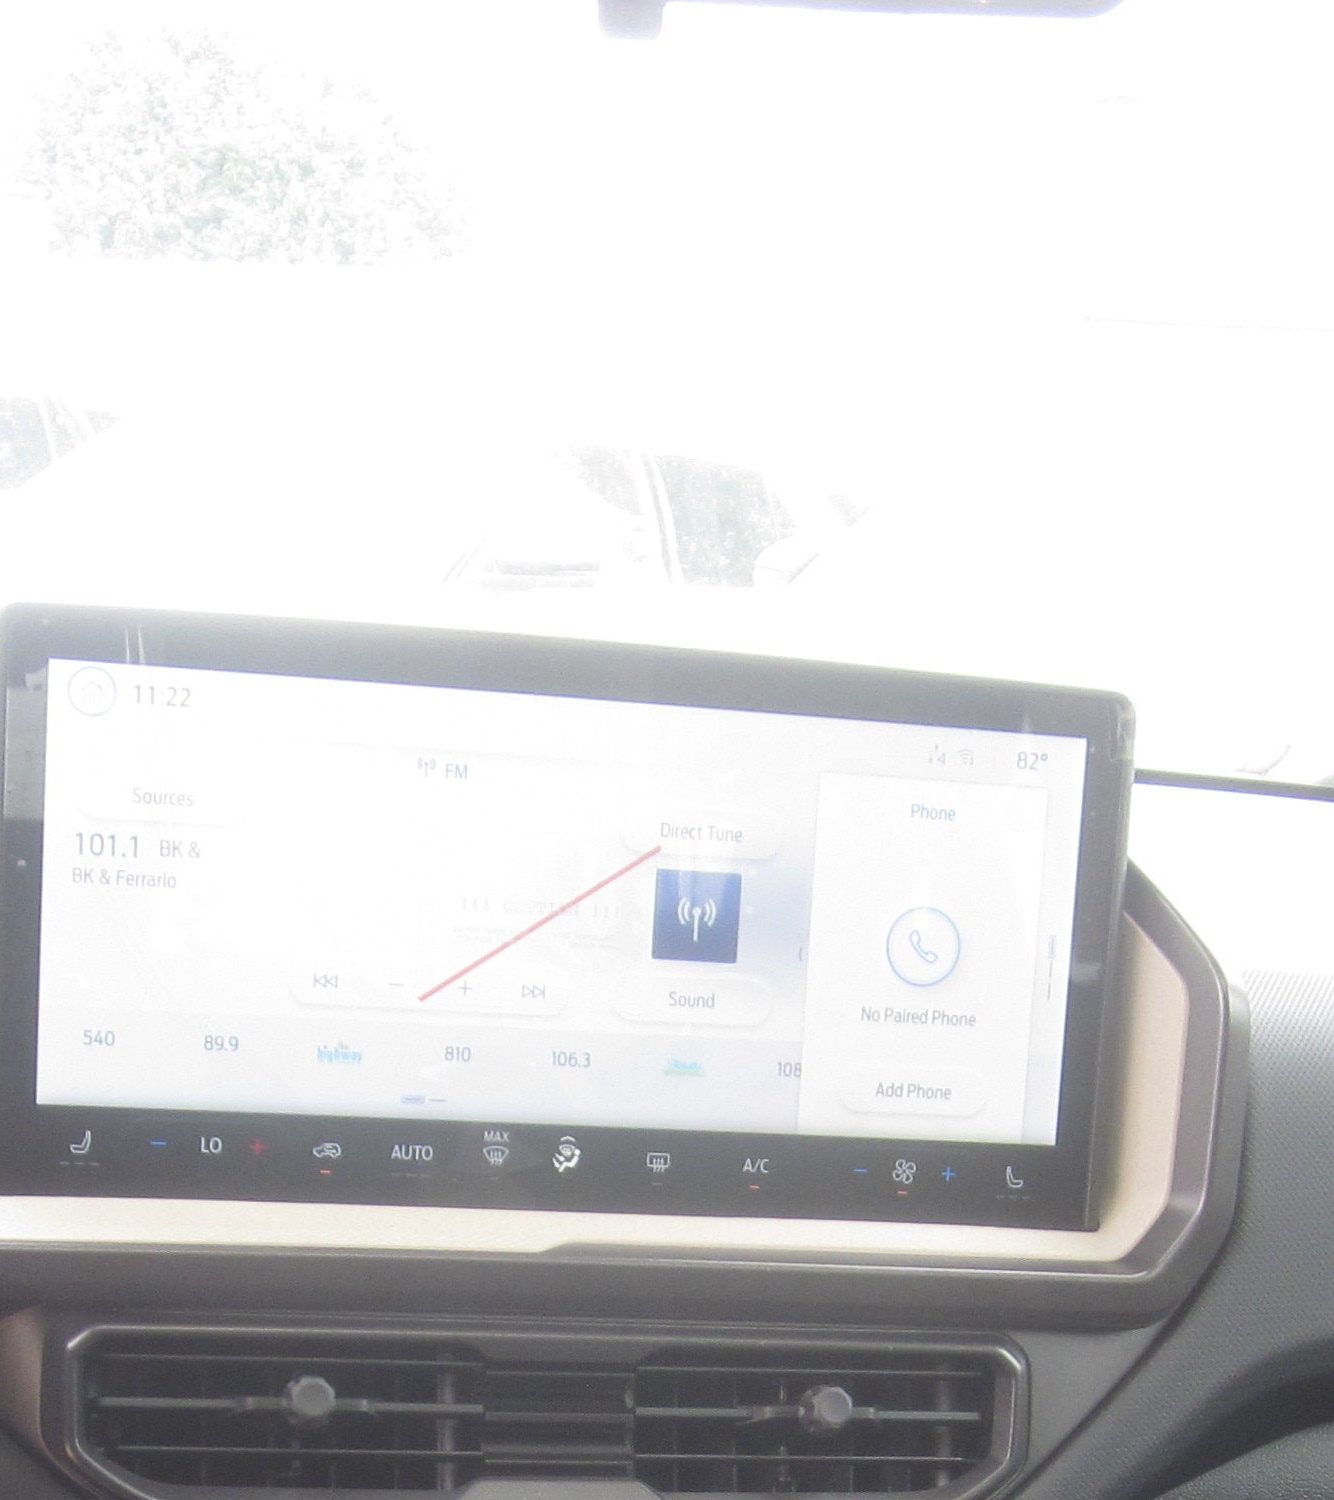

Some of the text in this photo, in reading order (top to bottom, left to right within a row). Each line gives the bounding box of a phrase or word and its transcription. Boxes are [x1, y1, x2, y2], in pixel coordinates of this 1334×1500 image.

[133, 684, 192, 708] 11:22
[1016, 751, 1049, 771] 82°
[445, 763, 469, 780] FM
[132, 787, 195, 808] Sources
[910, 803, 957, 822] Phone
[660, 822, 744, 843] Direct Tune
[75, 831, 202, 859] 101.1 BK &
[72, 868, 95, 885] BK
[99, 869, 112, 886] &
[668, 991, 715, 1010] Sound
[861, 1007, 977, 1028] No Paired Phone
[83, 1029, 116, 1048] 540
[203, 1033, 240, 1053] 89.9
[444, 1046, 472, 1063] 810
[552, 1051, 592, 1069] 106.3
[875, 1083, 952, 1101] Add Phone
[200, 1136, 223, 1155] LO
[483, 1131, 510, 1144] MAX
[391, 1145, 434, 1162] AUTO
[743, 1157, 769, 1175] A/C
